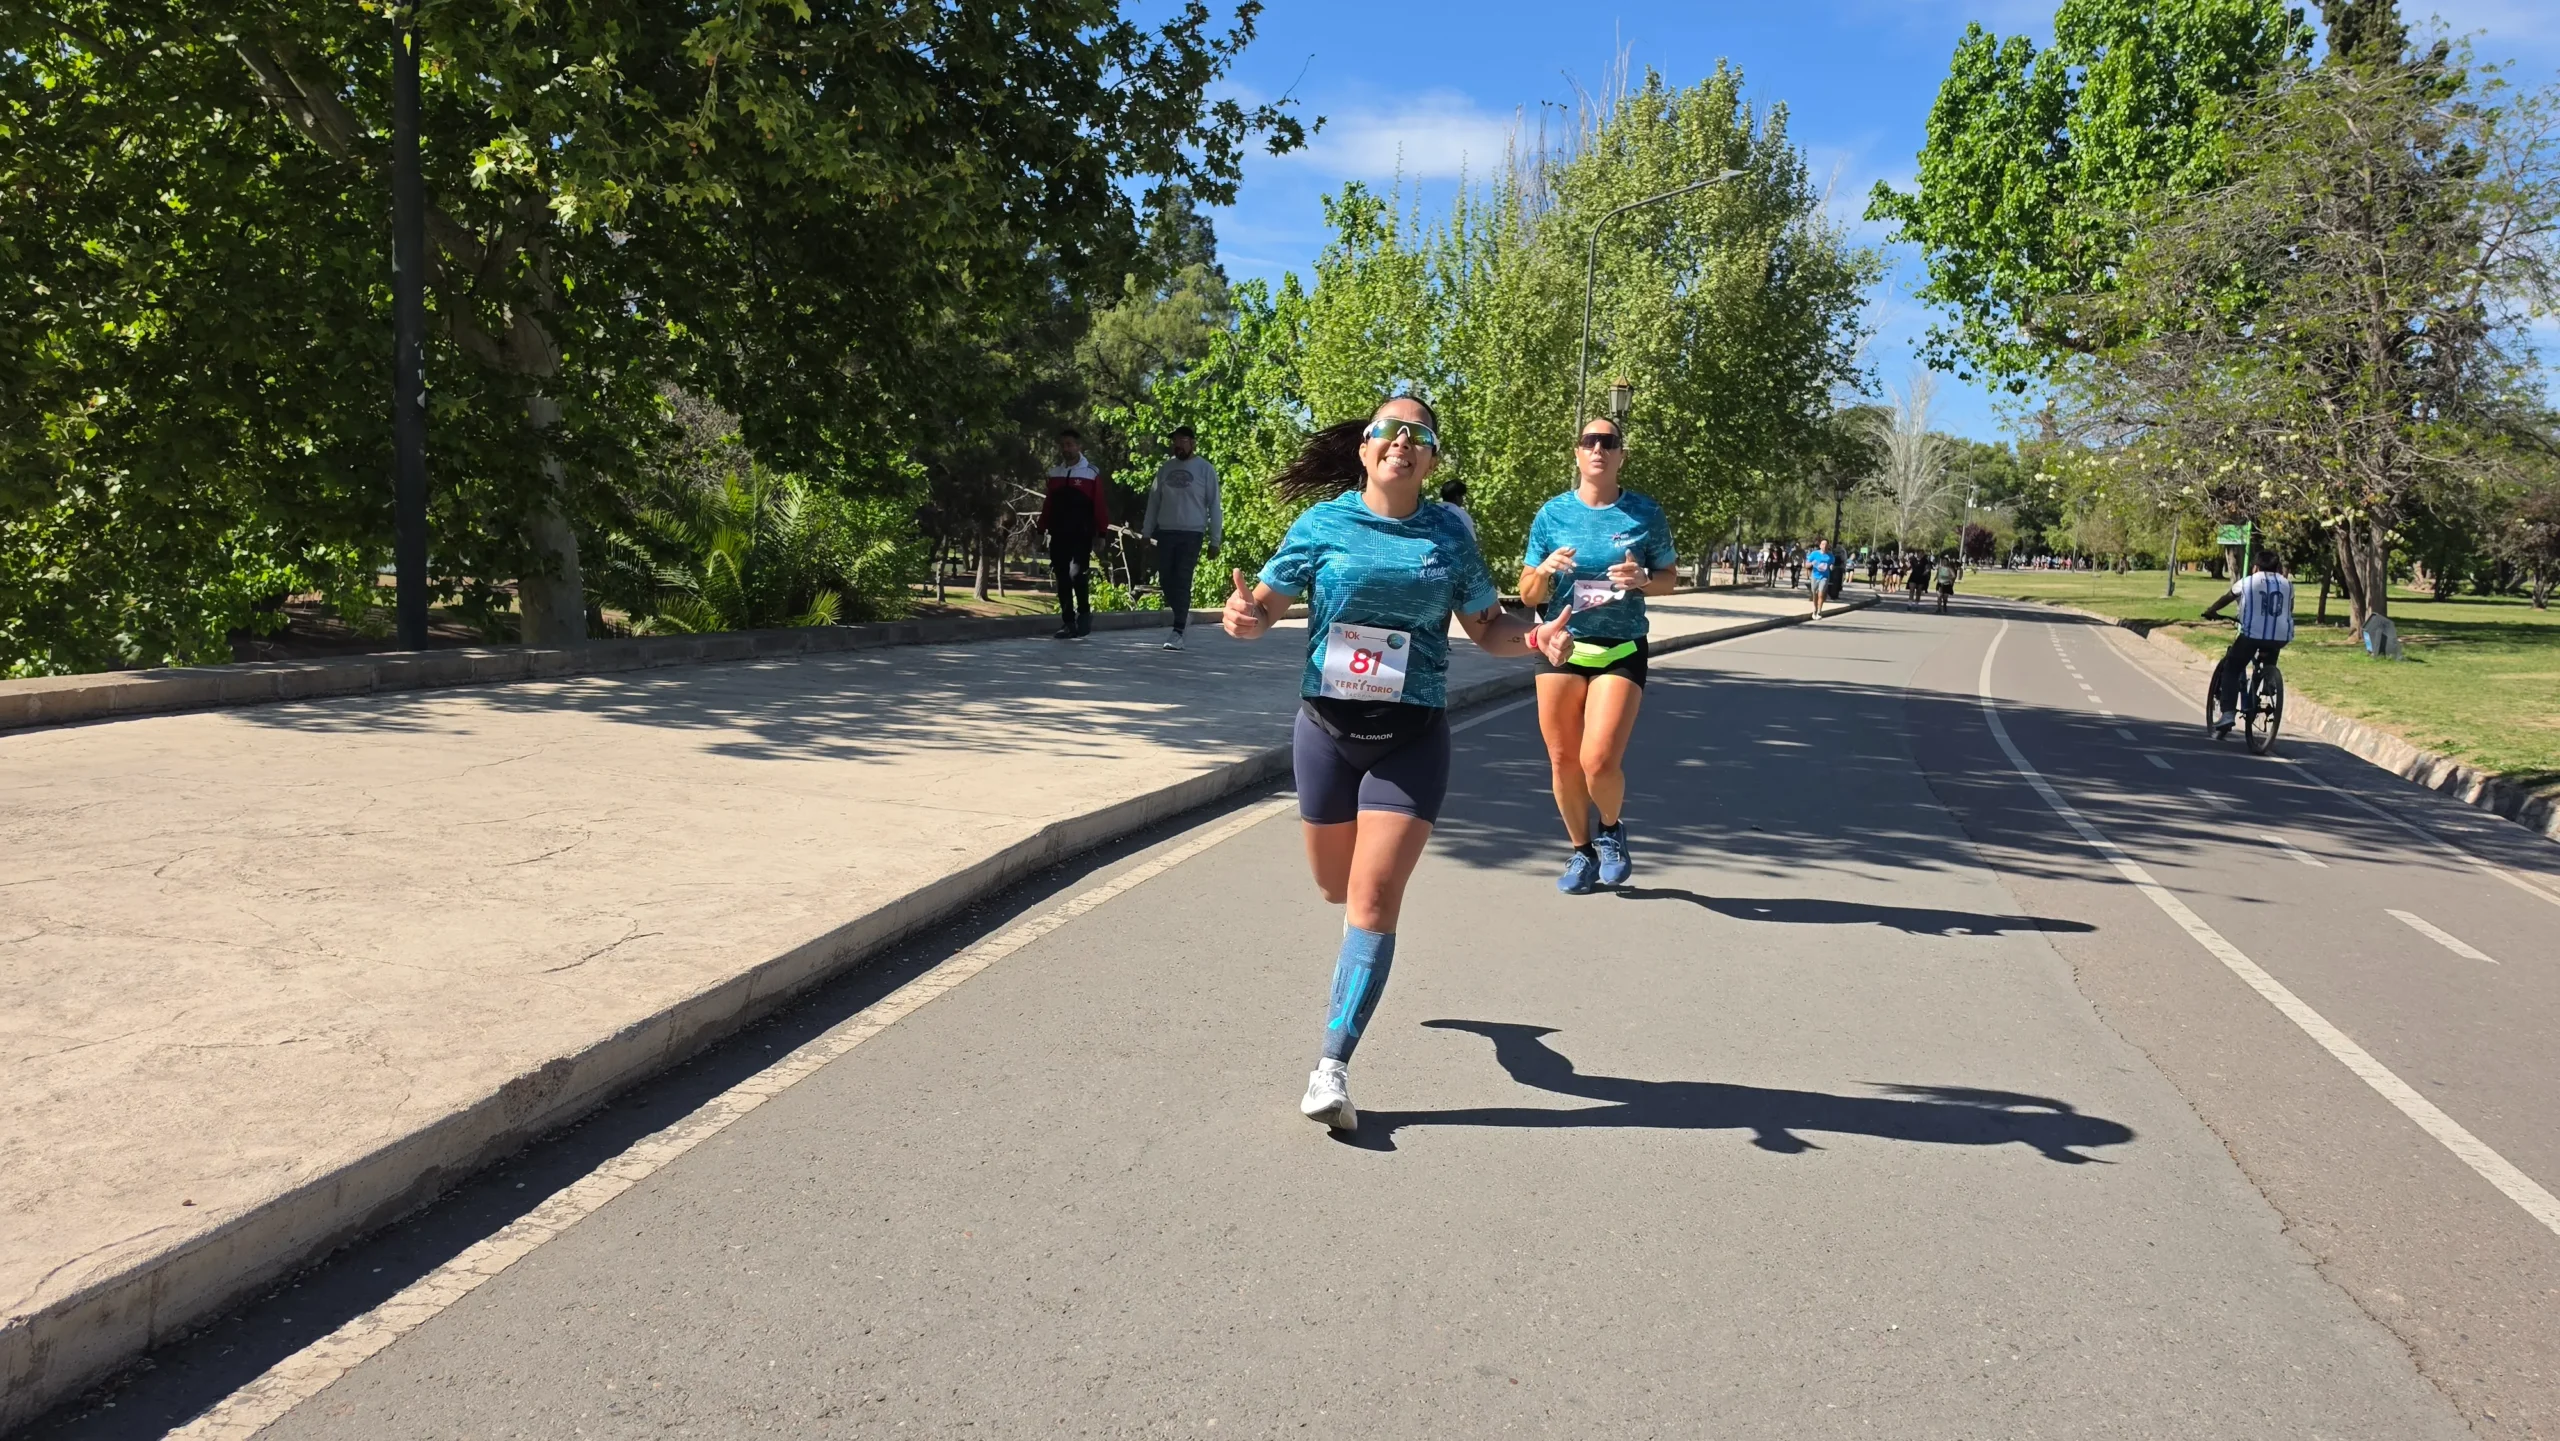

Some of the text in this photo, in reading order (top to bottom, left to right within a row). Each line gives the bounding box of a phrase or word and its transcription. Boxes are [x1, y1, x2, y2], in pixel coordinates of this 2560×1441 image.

[2259, 590, 2284, 617] 10
[1348, 648, 1384, 676] 81
[1350, 732, 1393, 740] SALOMON
